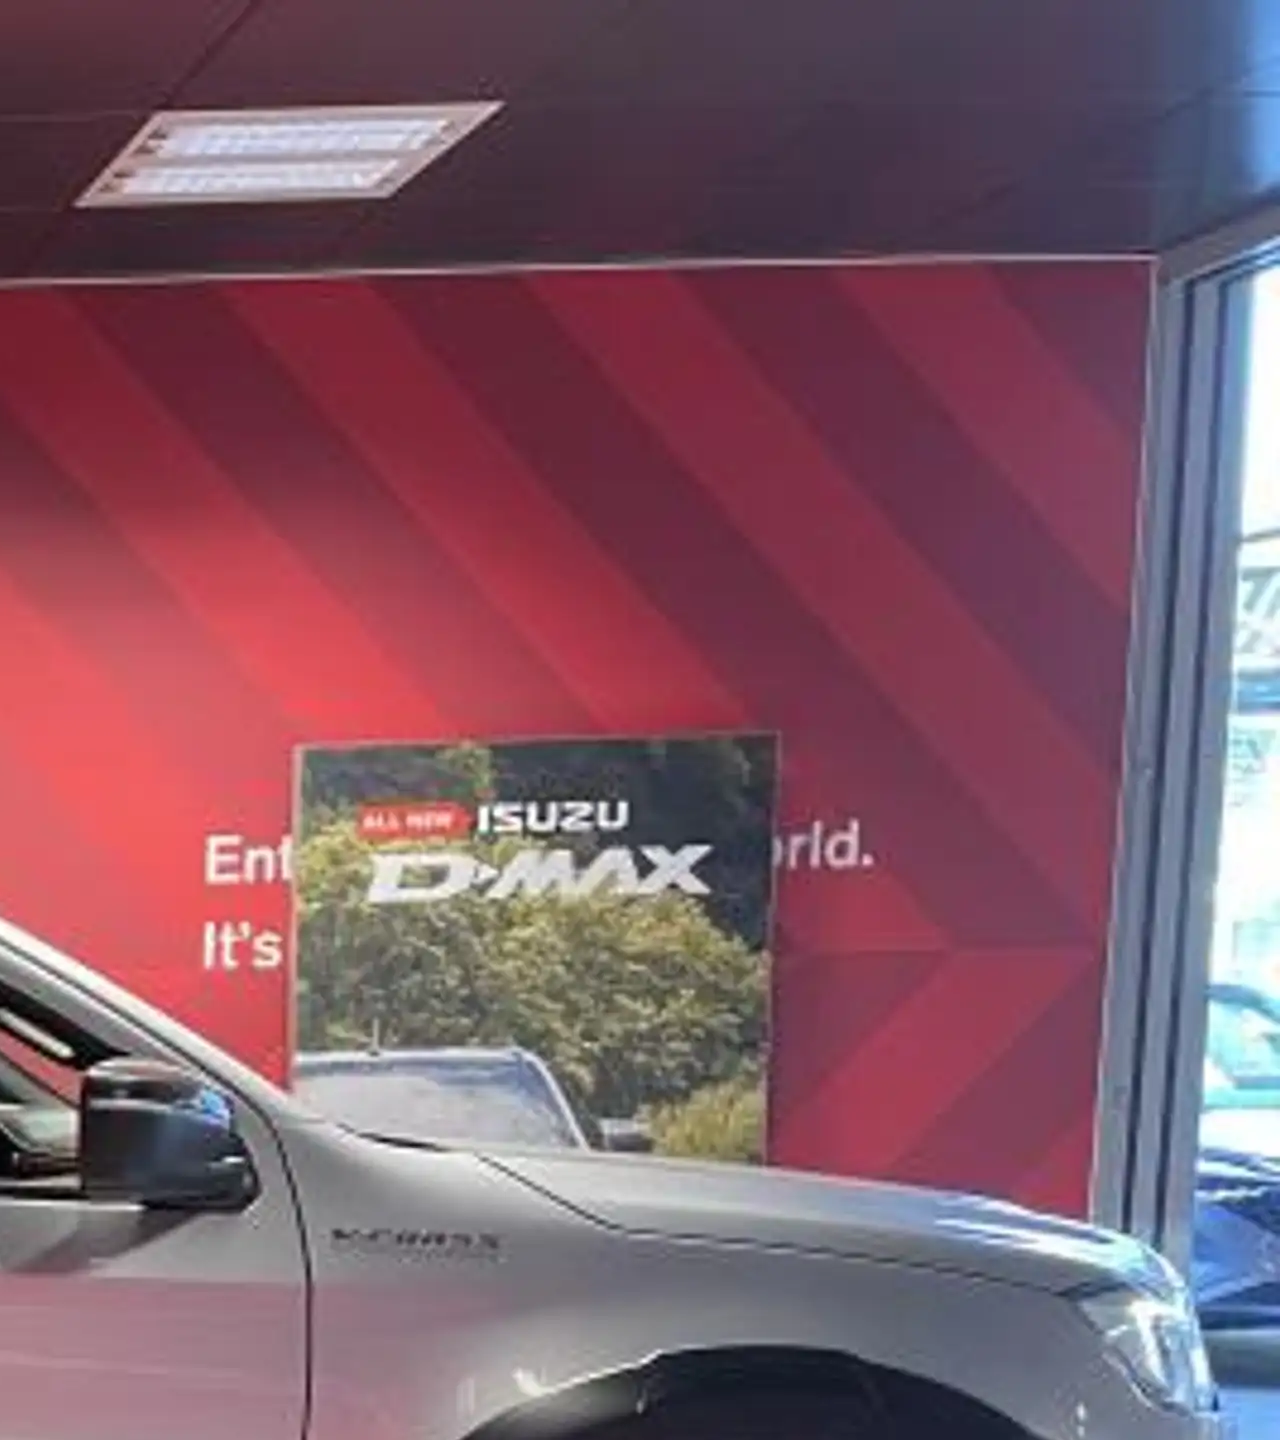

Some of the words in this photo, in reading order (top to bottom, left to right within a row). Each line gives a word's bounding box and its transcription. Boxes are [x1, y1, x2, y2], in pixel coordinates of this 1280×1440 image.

[477, 801, 629, 832] ISUZU
[368, 844, 714, 901] D-MAX
[203, 922, 283, 970] It's
